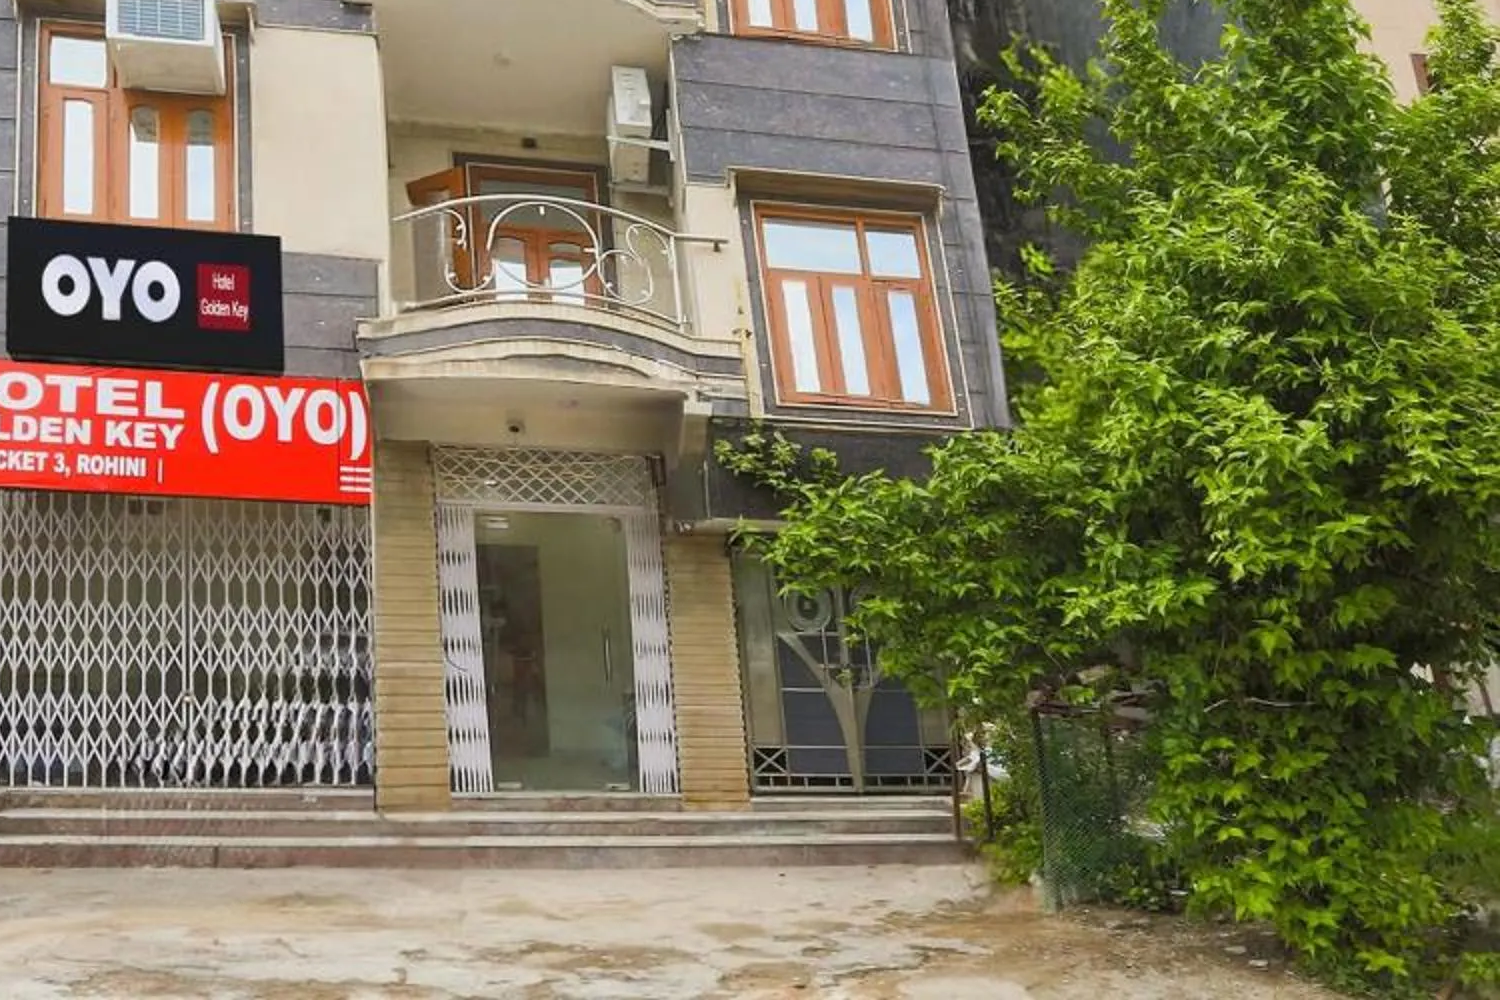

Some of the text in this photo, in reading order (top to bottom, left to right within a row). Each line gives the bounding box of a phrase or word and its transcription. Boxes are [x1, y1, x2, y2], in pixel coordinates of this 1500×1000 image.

[42, 254, 181, 322] OYO
[212, 272, 235, 291] Hotel
[200, 298, 249, 322] Golden Key
[104, 419, 185, 451] KEY
[201, 382, 367, 461] (OYO)
[53, 452, 71, 479] 3,
[76, 453, 147, 478] ROHINI
